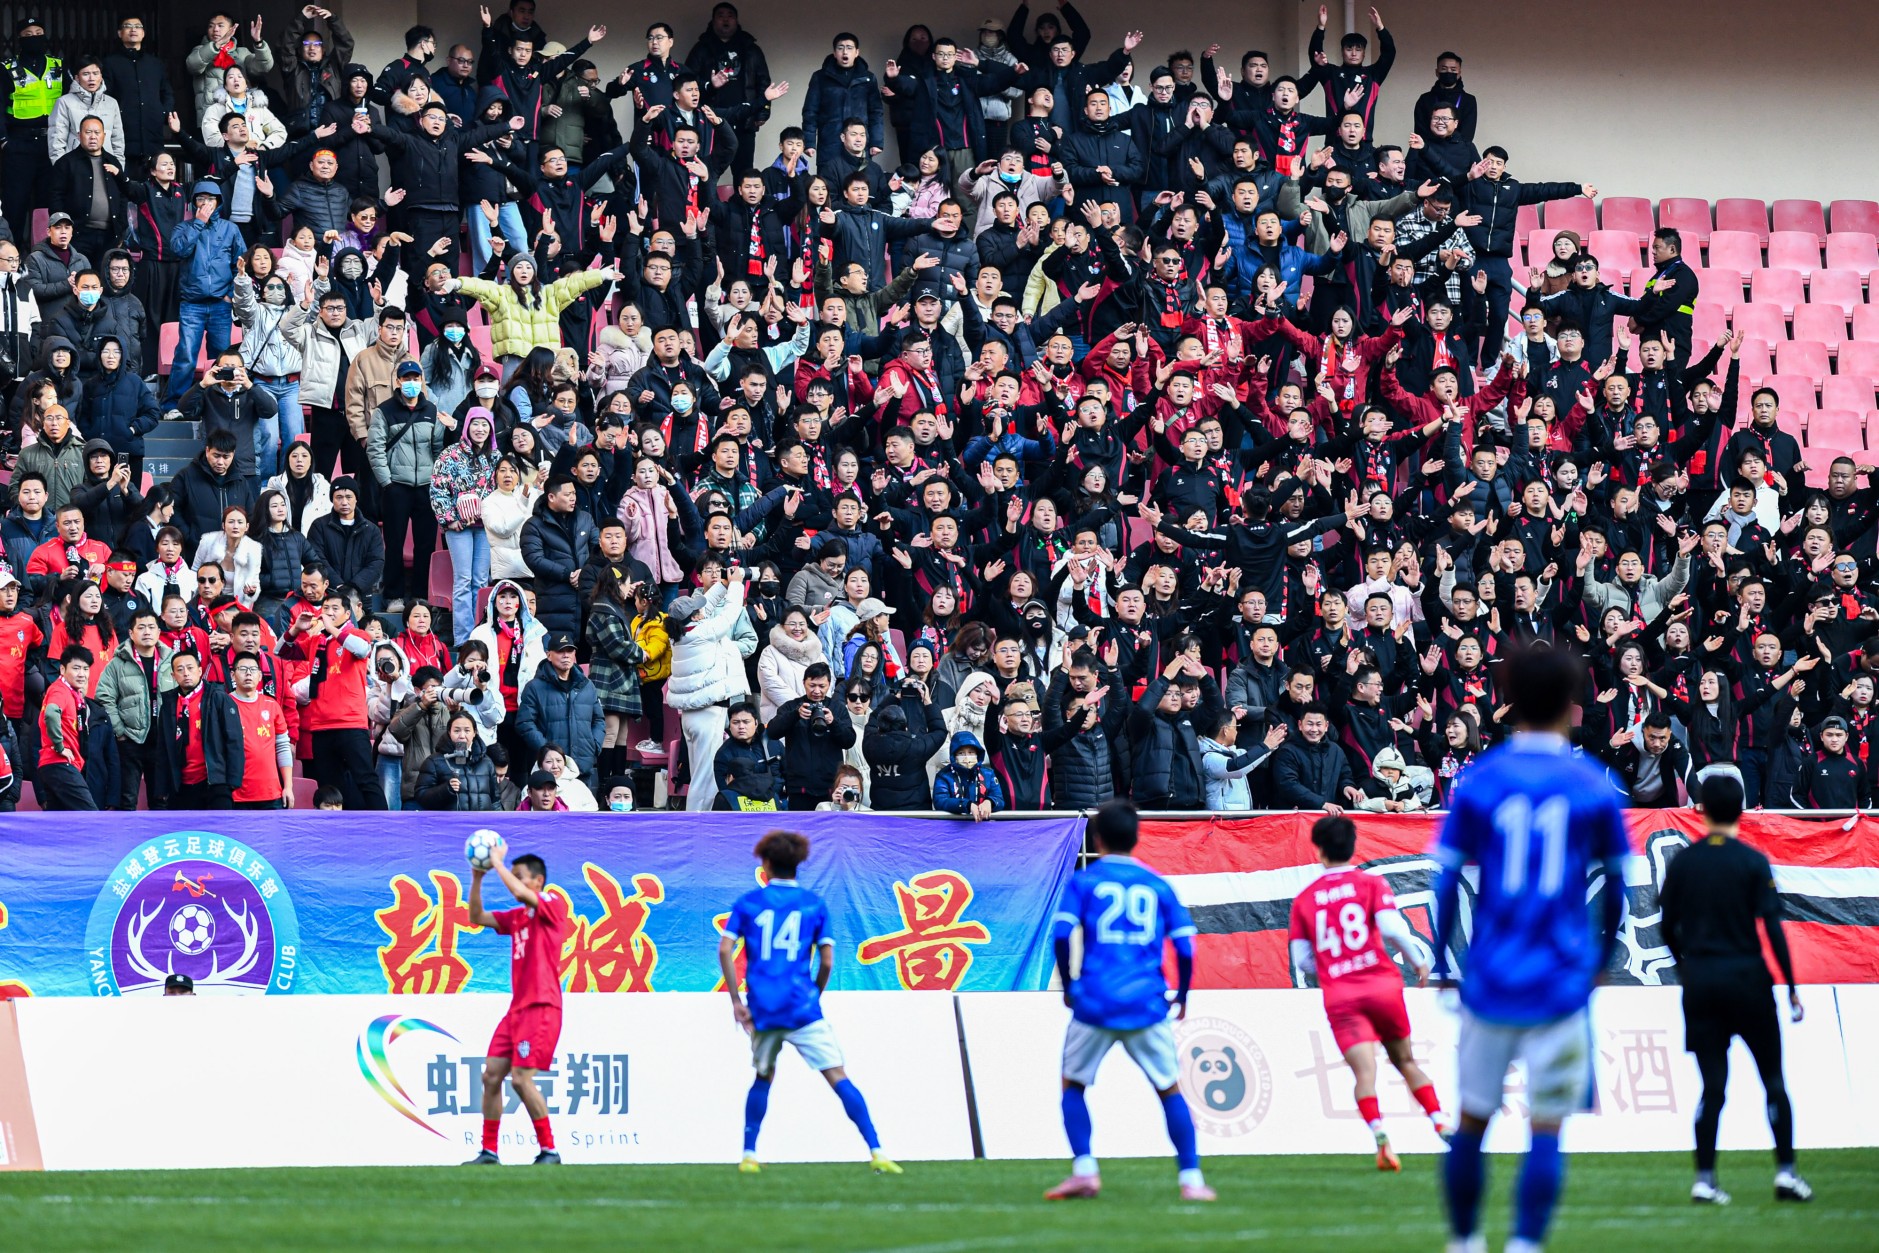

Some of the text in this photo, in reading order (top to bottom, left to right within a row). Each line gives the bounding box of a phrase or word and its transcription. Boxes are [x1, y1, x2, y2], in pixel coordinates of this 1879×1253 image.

[148, 462, 156, 474] 3
[112, 836, 279, 900] 盐城登云足球俱乐部
[1492, 795, 1569, 897] 11
[754, 909, 803, 962] 14
[1093, 881, 1158, 946] 29
[1315, 902, 1369, 958] 48
[89, 946, 114, 997] YANC
[276, 945, 296, 991] CLUB
[571, 1130, 640, 1149] Sprint
